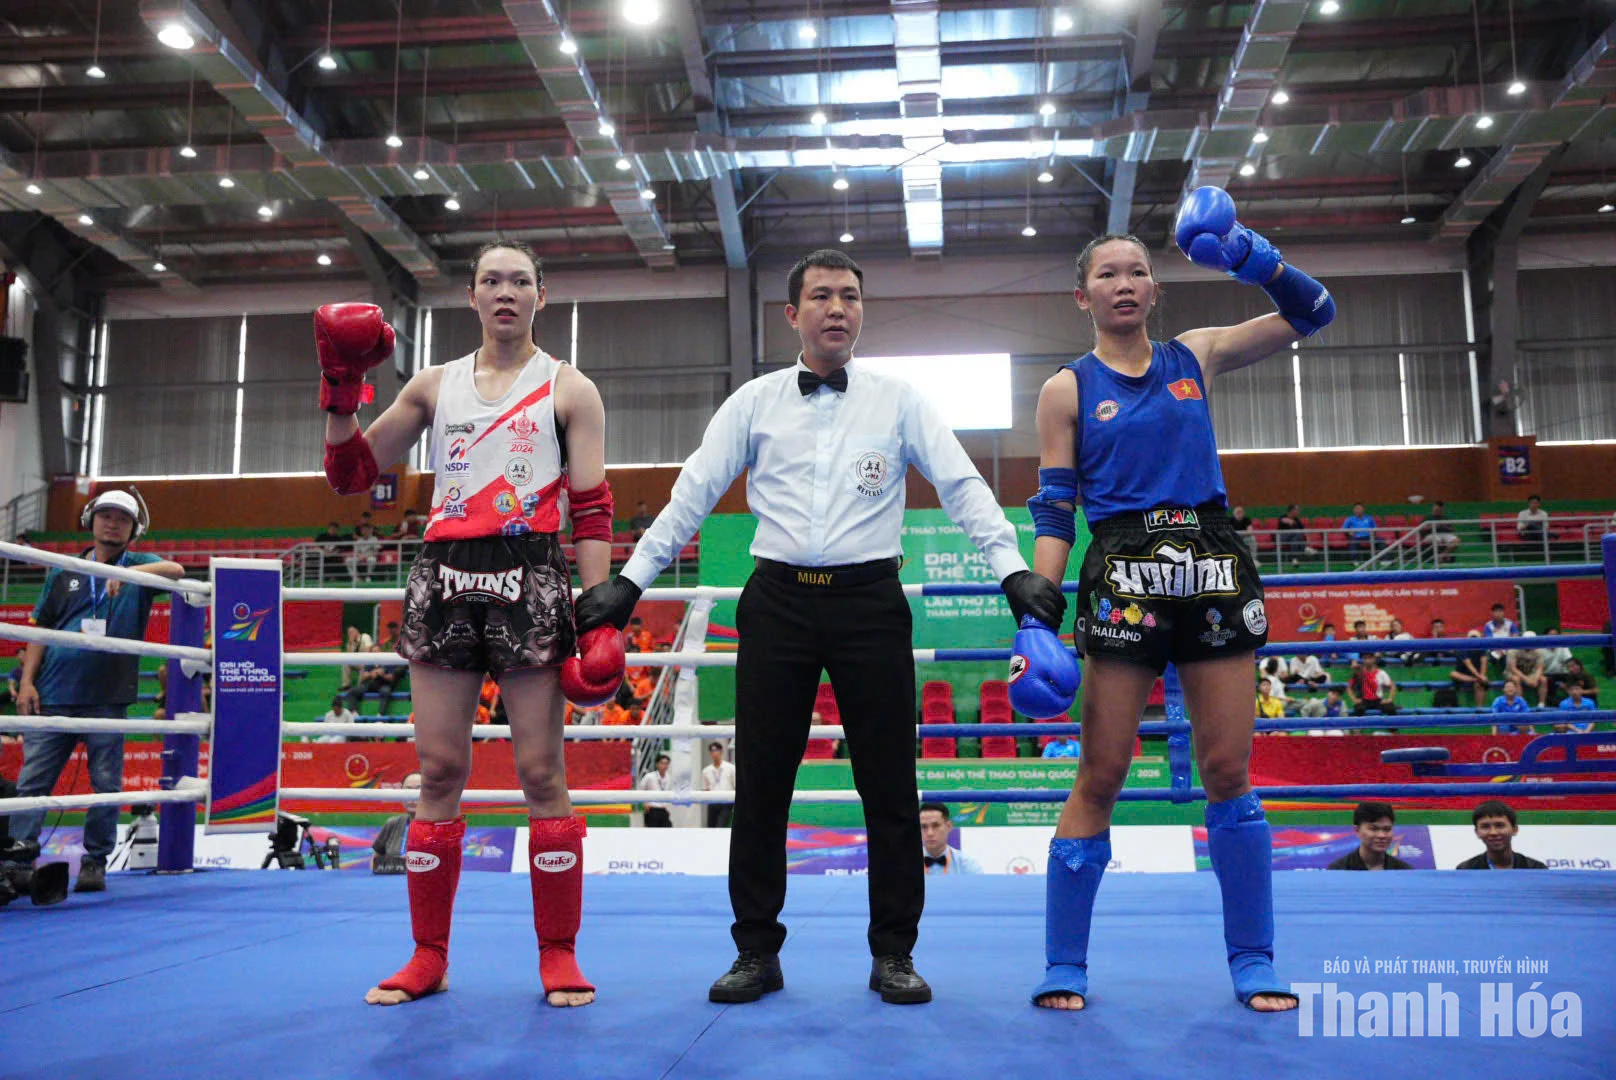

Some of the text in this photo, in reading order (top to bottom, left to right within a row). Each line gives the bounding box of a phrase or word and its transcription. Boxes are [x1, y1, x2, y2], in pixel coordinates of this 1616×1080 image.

[510, 443, 534, 454] 2024
[445, 462, 470, 472] NSDF
[1505, 457, 1527, 473] B2
[856, 484, 884, 497] REFEREE
[1149, 509, 1196, 526] IFMA
[438, 563, 524, 602] TWINS
[797, 570, 833, 585] MUAY
[1091, 625, 1142, 642] THAILAND
